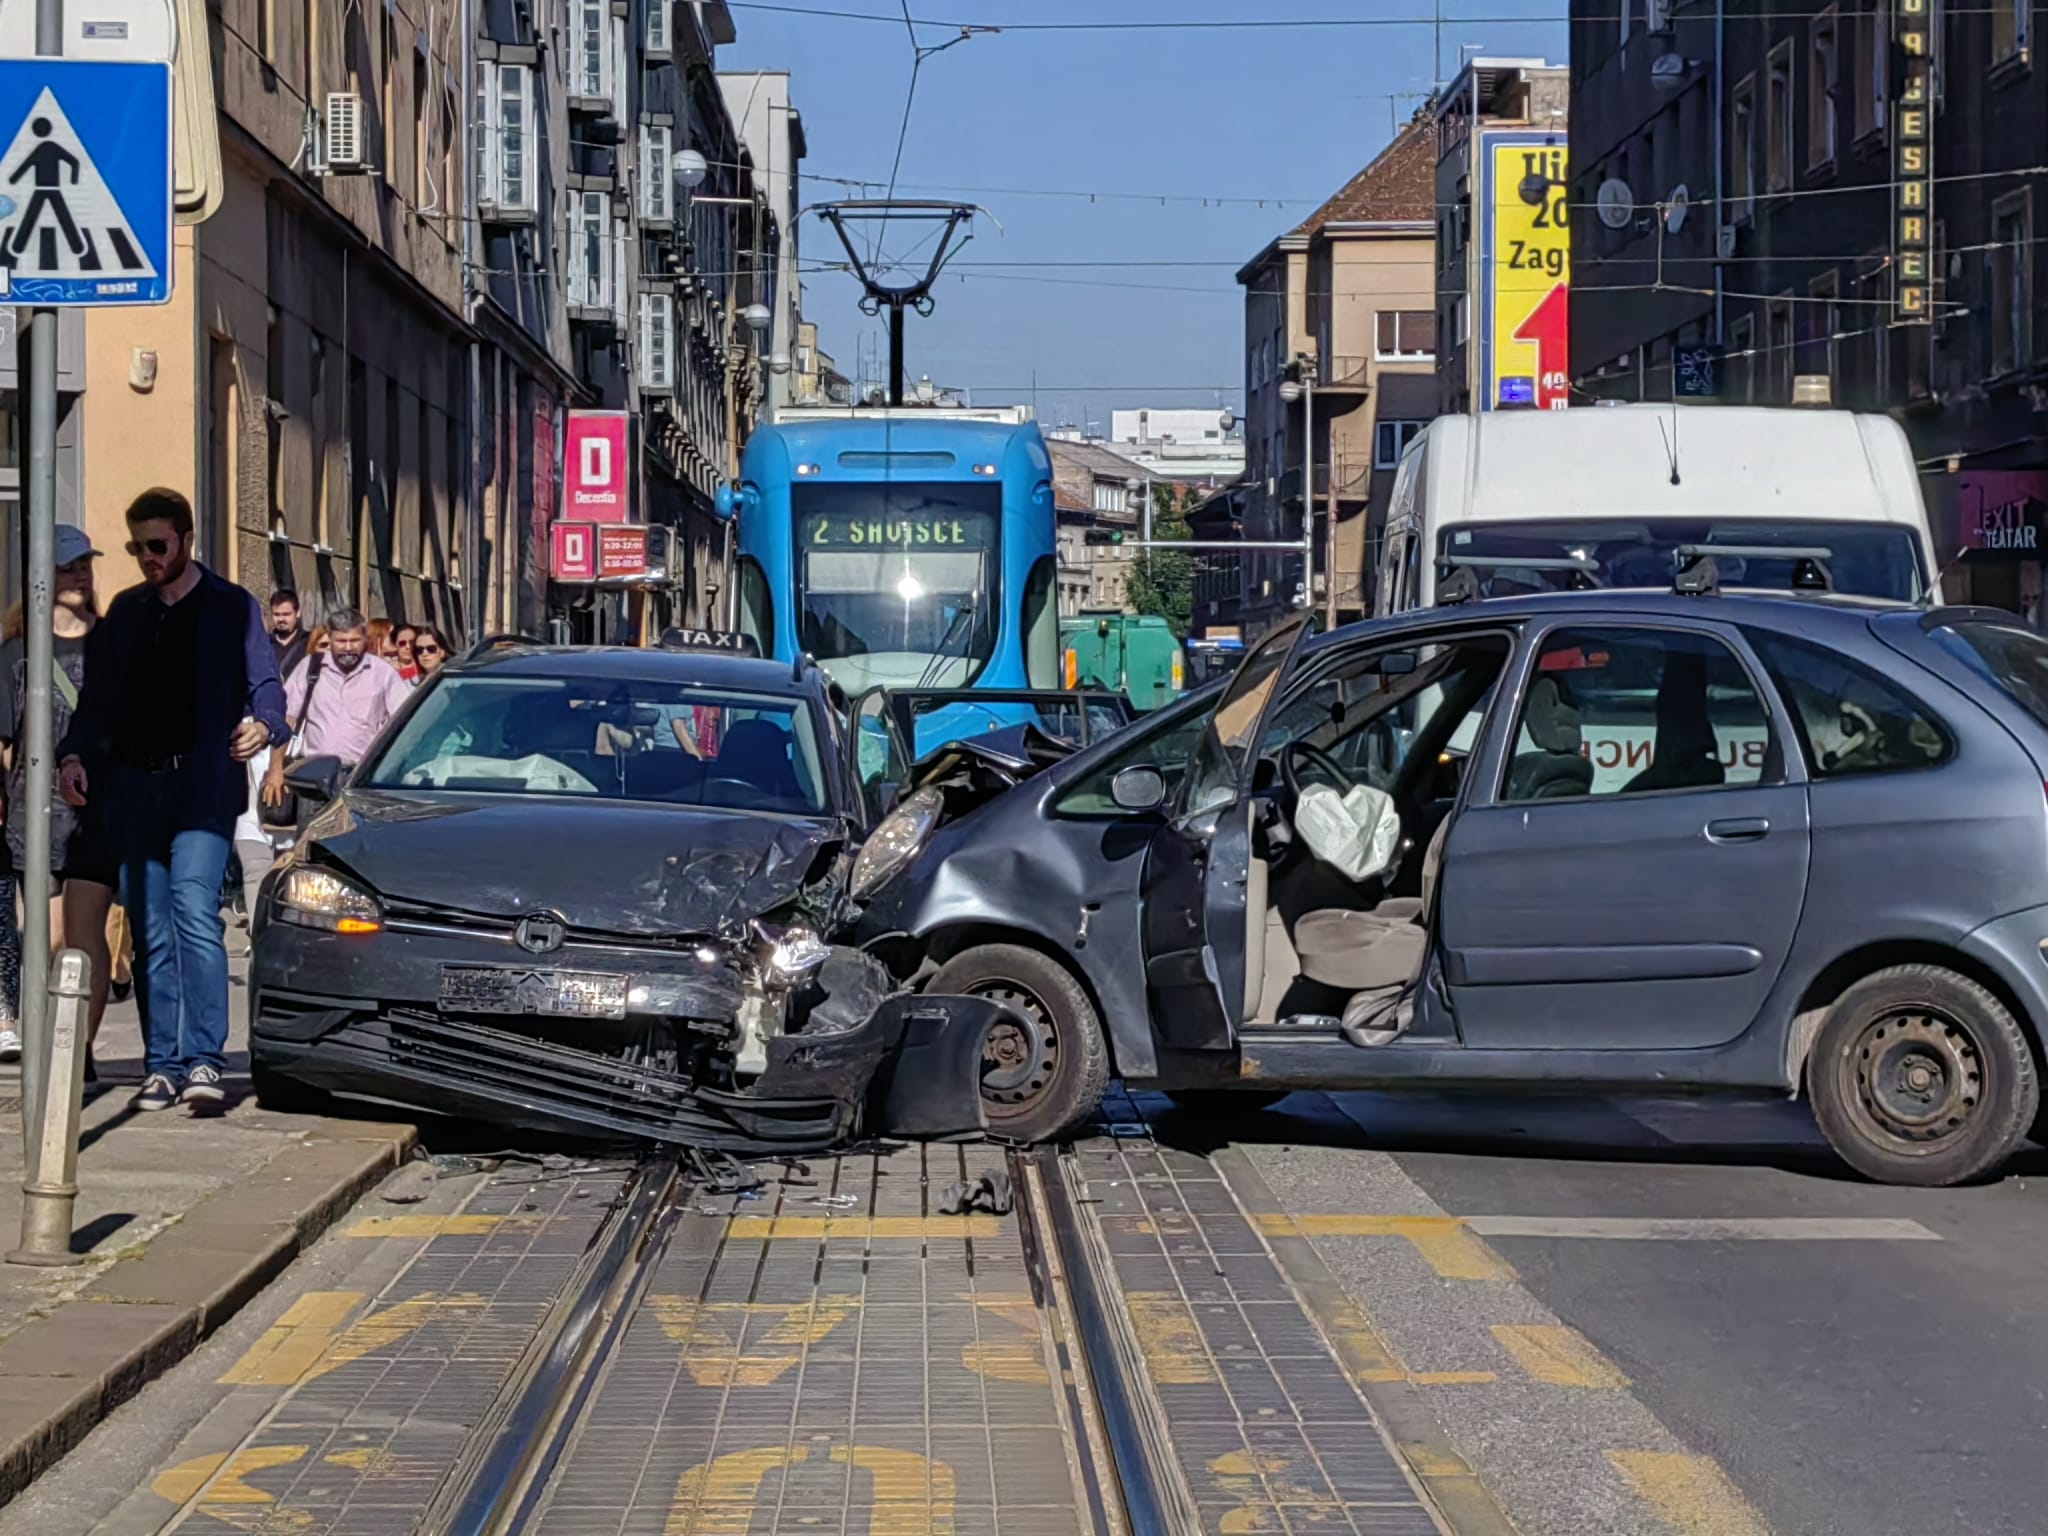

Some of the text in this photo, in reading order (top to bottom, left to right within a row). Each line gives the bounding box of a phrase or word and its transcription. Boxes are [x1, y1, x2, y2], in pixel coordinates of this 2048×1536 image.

[1509, 240, 1569, 278] Zag
[1983, 497, 2030, 530] EXIT
[813, 520, 829, 544] 2
[677, 628, 743, 649] TAXI
